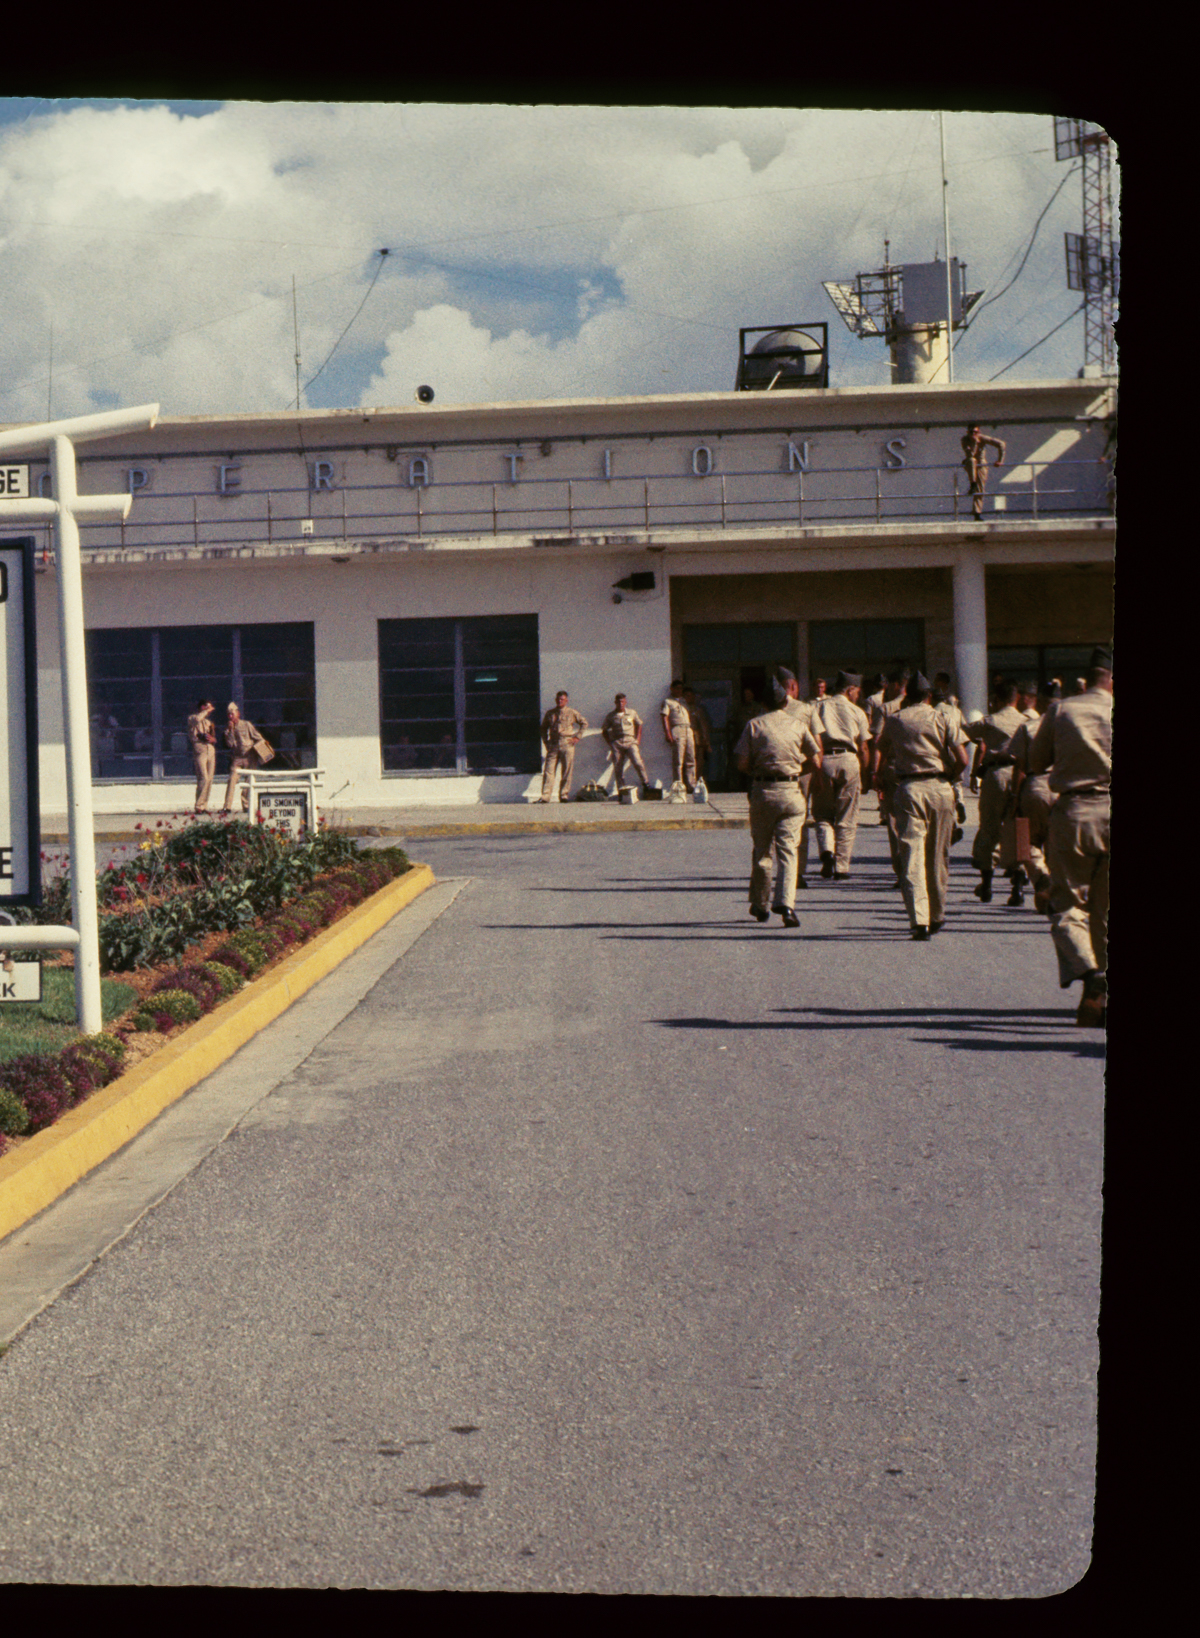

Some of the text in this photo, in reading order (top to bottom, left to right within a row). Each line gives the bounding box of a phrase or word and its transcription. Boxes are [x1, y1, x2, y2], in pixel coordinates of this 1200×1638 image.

[261, 798, 305, 808] NO SMOKING
[269, 808, 296, 818] BEYOND
[275, 819, 291, 828] THIS
